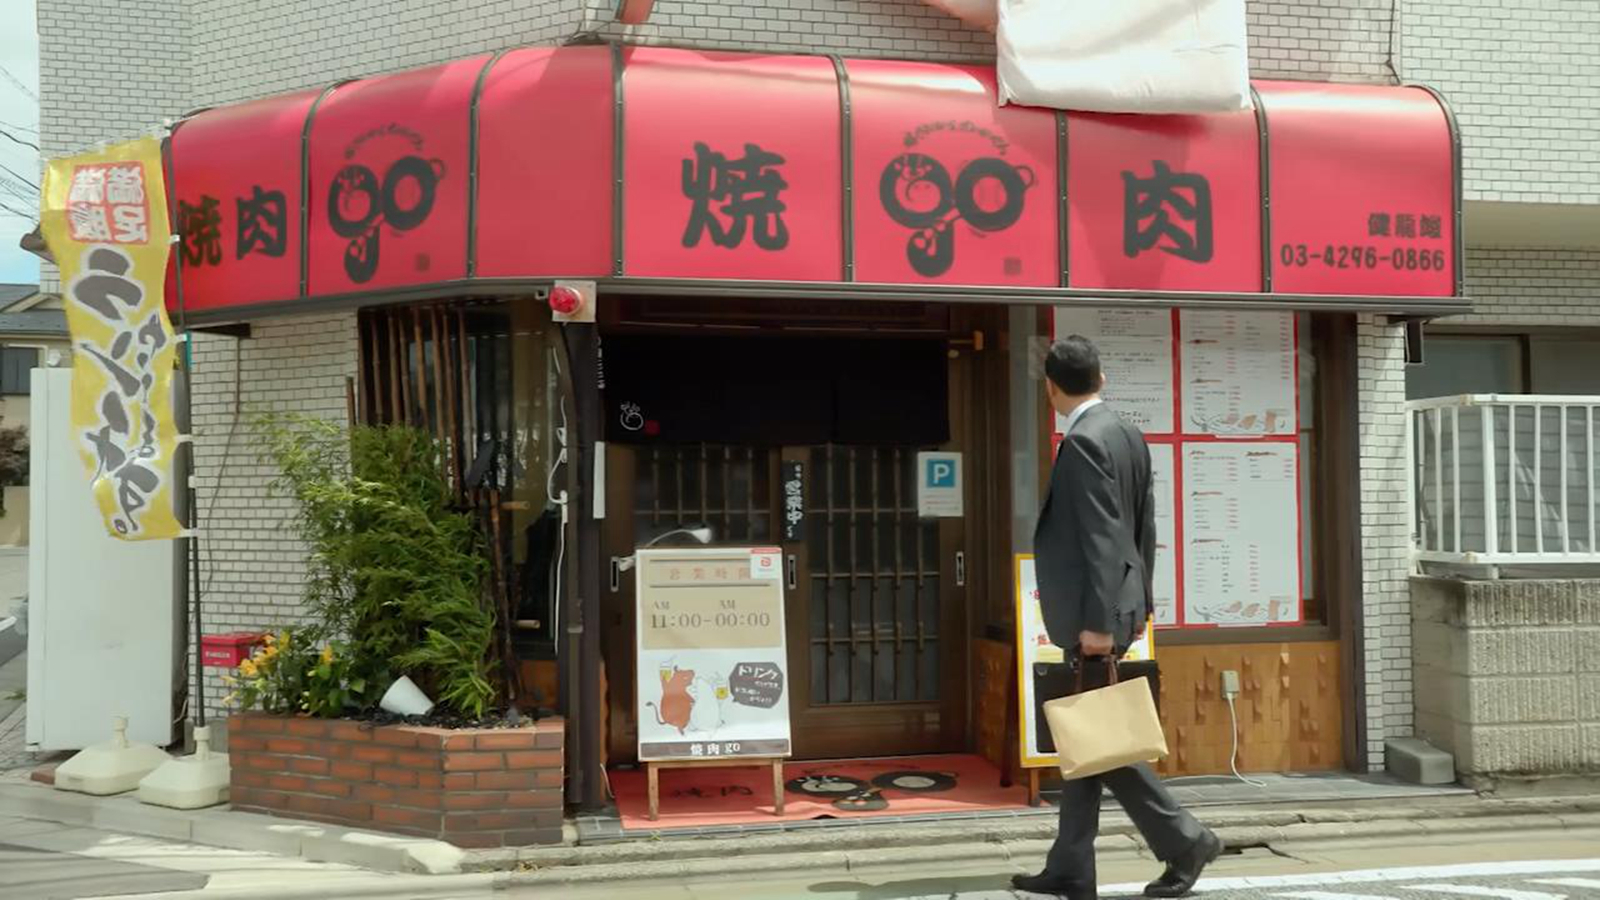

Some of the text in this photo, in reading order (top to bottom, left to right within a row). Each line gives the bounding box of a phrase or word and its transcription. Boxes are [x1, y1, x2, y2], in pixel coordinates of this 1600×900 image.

[680, 141, 789, 251] 焼
[1120, 159, 1214, 264] 肉
[933, 463, 950, 484] P
